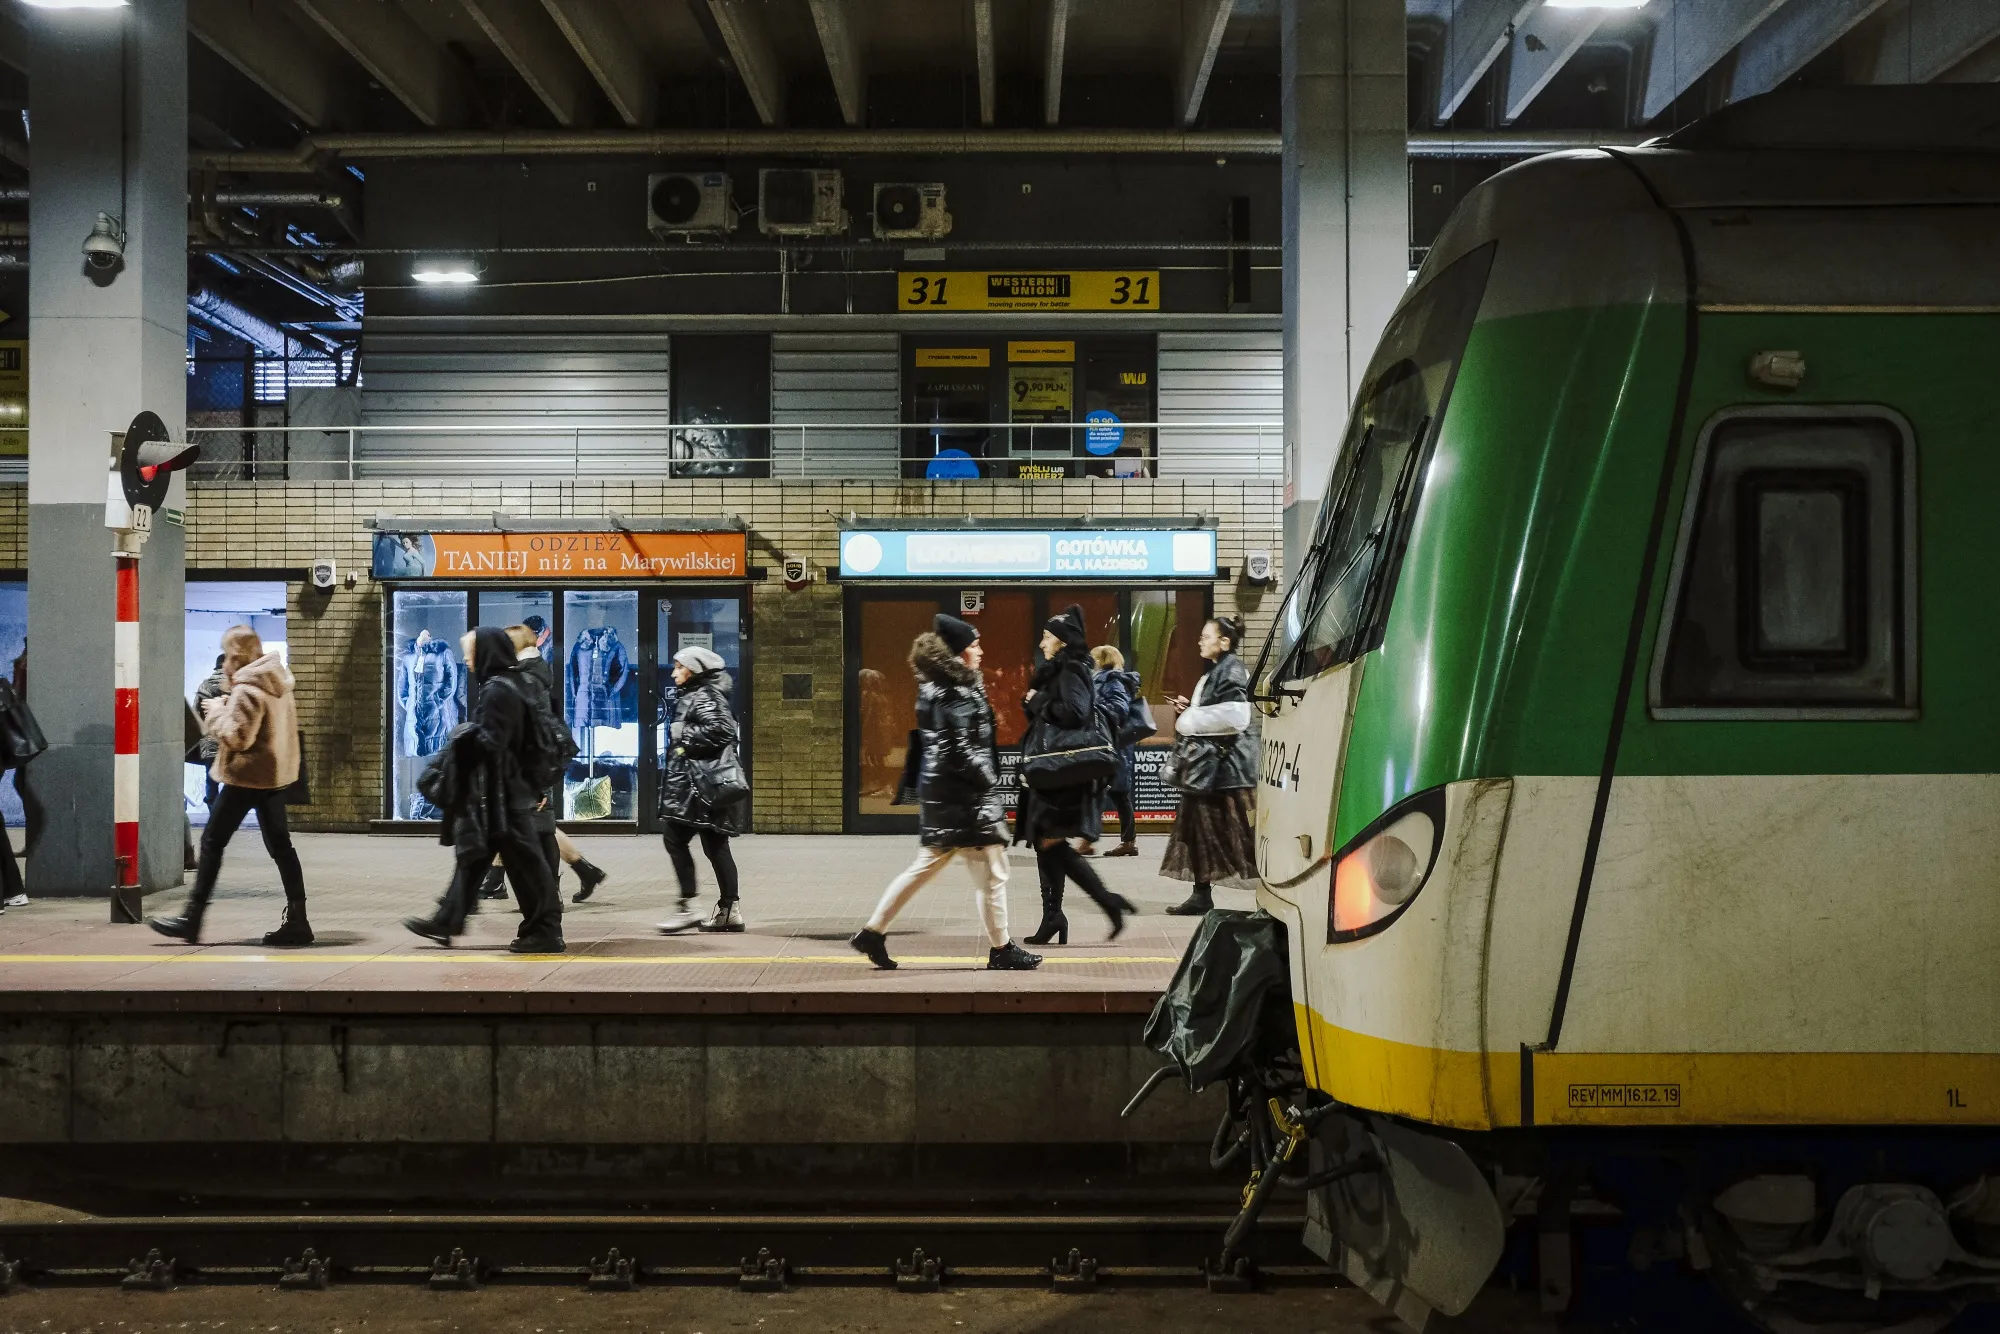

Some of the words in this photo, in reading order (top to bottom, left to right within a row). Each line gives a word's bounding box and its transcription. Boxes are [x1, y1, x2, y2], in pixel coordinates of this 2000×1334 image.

[908, 276, 948, 305] 31
[991, 277, 1055, 286] WESTERN
[1110, 276, 1150, 305] 31
[1011, 286, 1055, 295] UNION
[1019, 464, 1051, 473] WYŚLIJ
[530, 535, 621, 552] ODZIEŻ
[1055, 536, 1149, 556] GOTÓWKA
[443, 550, 529, 574] TANIEJ
[538, 553, 572, 571] niż
[583, 556, 608, 571] na
[620, 552, 736, 576] Marywilskiej
[1055, 558, 1083, 571] DLA
[1084, 556, 1149, 571] KAŻDEGO
[1134, 751, 1171, 762] WSZY
[1134, 764, 1158, 773] POD
[1571, 1088, 1596, 1102] REV
[1601, 1088, 1623, 1102] MM
[1946, 1088, 1967, 1108] 1L
